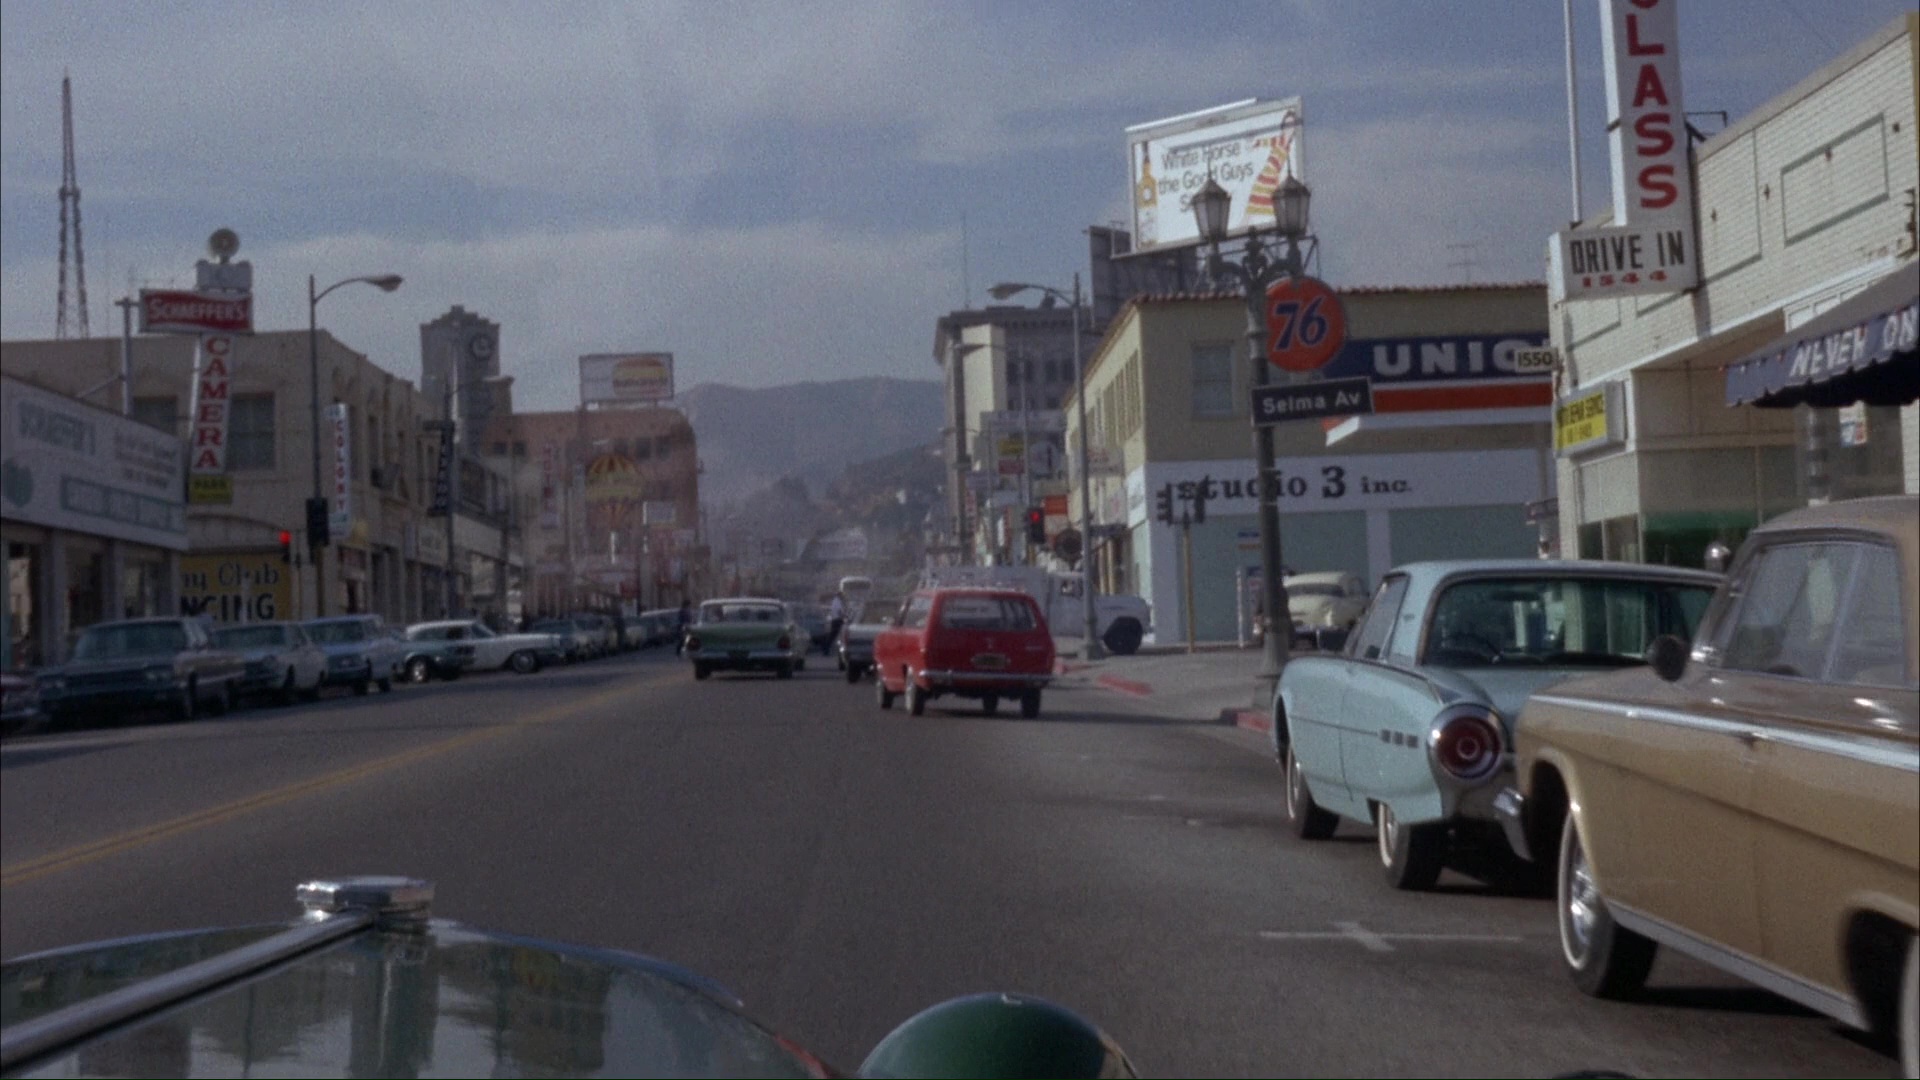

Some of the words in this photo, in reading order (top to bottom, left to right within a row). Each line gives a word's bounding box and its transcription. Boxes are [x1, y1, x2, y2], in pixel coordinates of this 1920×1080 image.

[1625, 0, 1678, 209] LASS
[1162, 149, 1199, 170] White
[1202, 142, 1241, 163] Horse
[1158, 176, 1180, 195] the
[1221, 161, 1254, 182] Guys
[1570, 235, 1643, 274] DRIVE
[1657, 230, 1685, 267] IN
[1273, 295, 1329, 353] 76
[1373, 337, 1550, 376] UNIO
[1517, 350, 1553, 368] 1550
[196, 336, 231, 469] CAMERA
[1263, 395, 1327, 415] Selma
[1335, 391, 1361, 407] Av
[1321, 466, 1346, 498] 3
